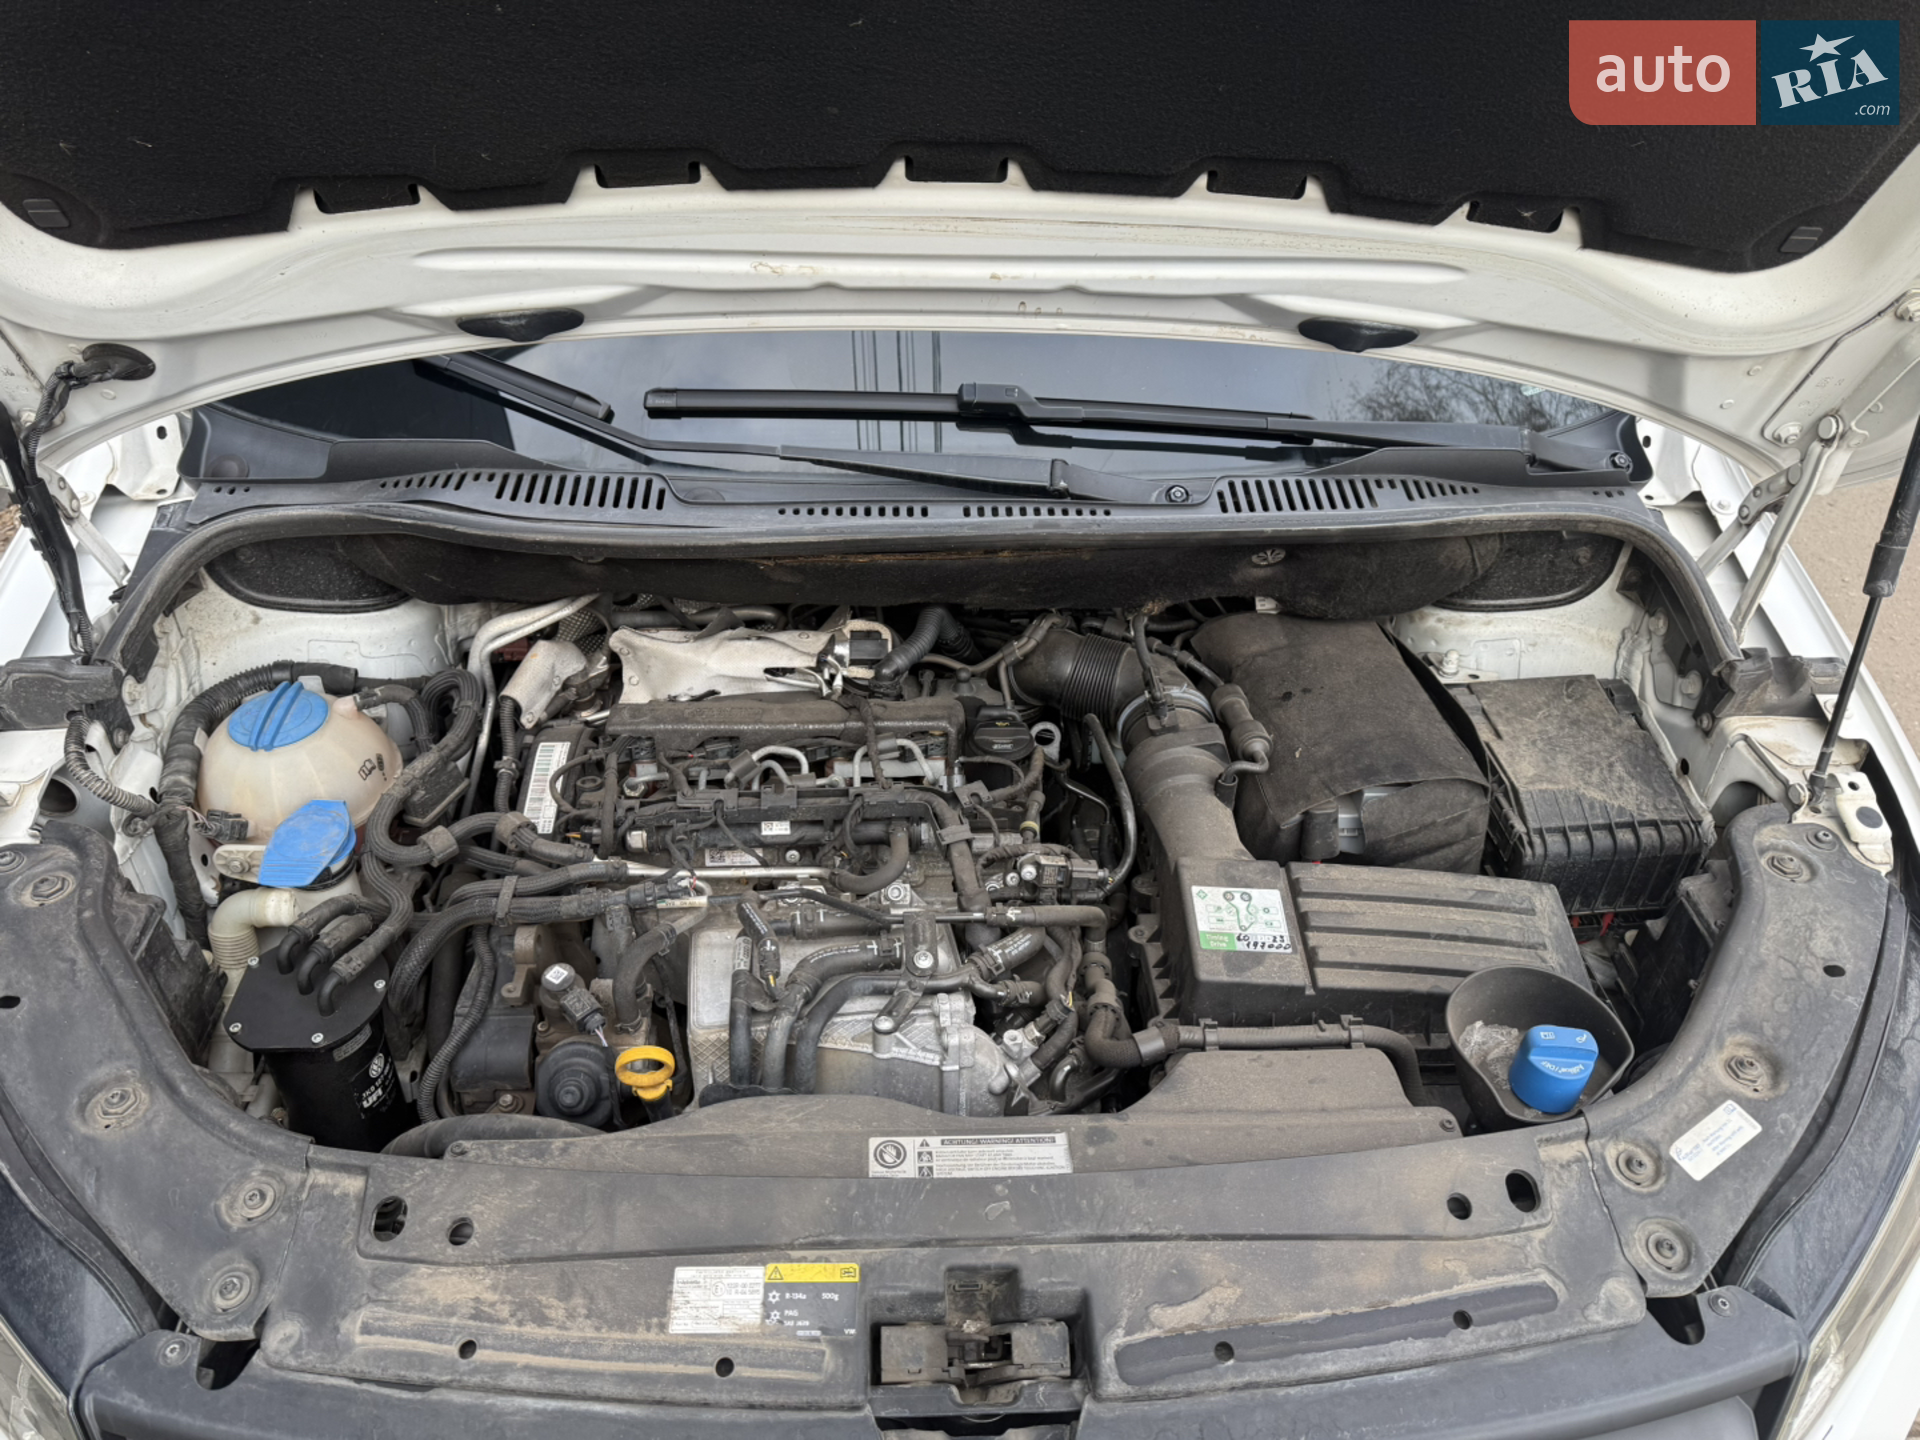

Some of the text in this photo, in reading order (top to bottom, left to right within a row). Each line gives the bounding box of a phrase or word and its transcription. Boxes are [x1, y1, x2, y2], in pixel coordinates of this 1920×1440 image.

[1206, 933, 1229, 942] Timing
[785, 1292, 839, 1301] R-134a 500g
[783, 1309, 799, 1317] PAG
